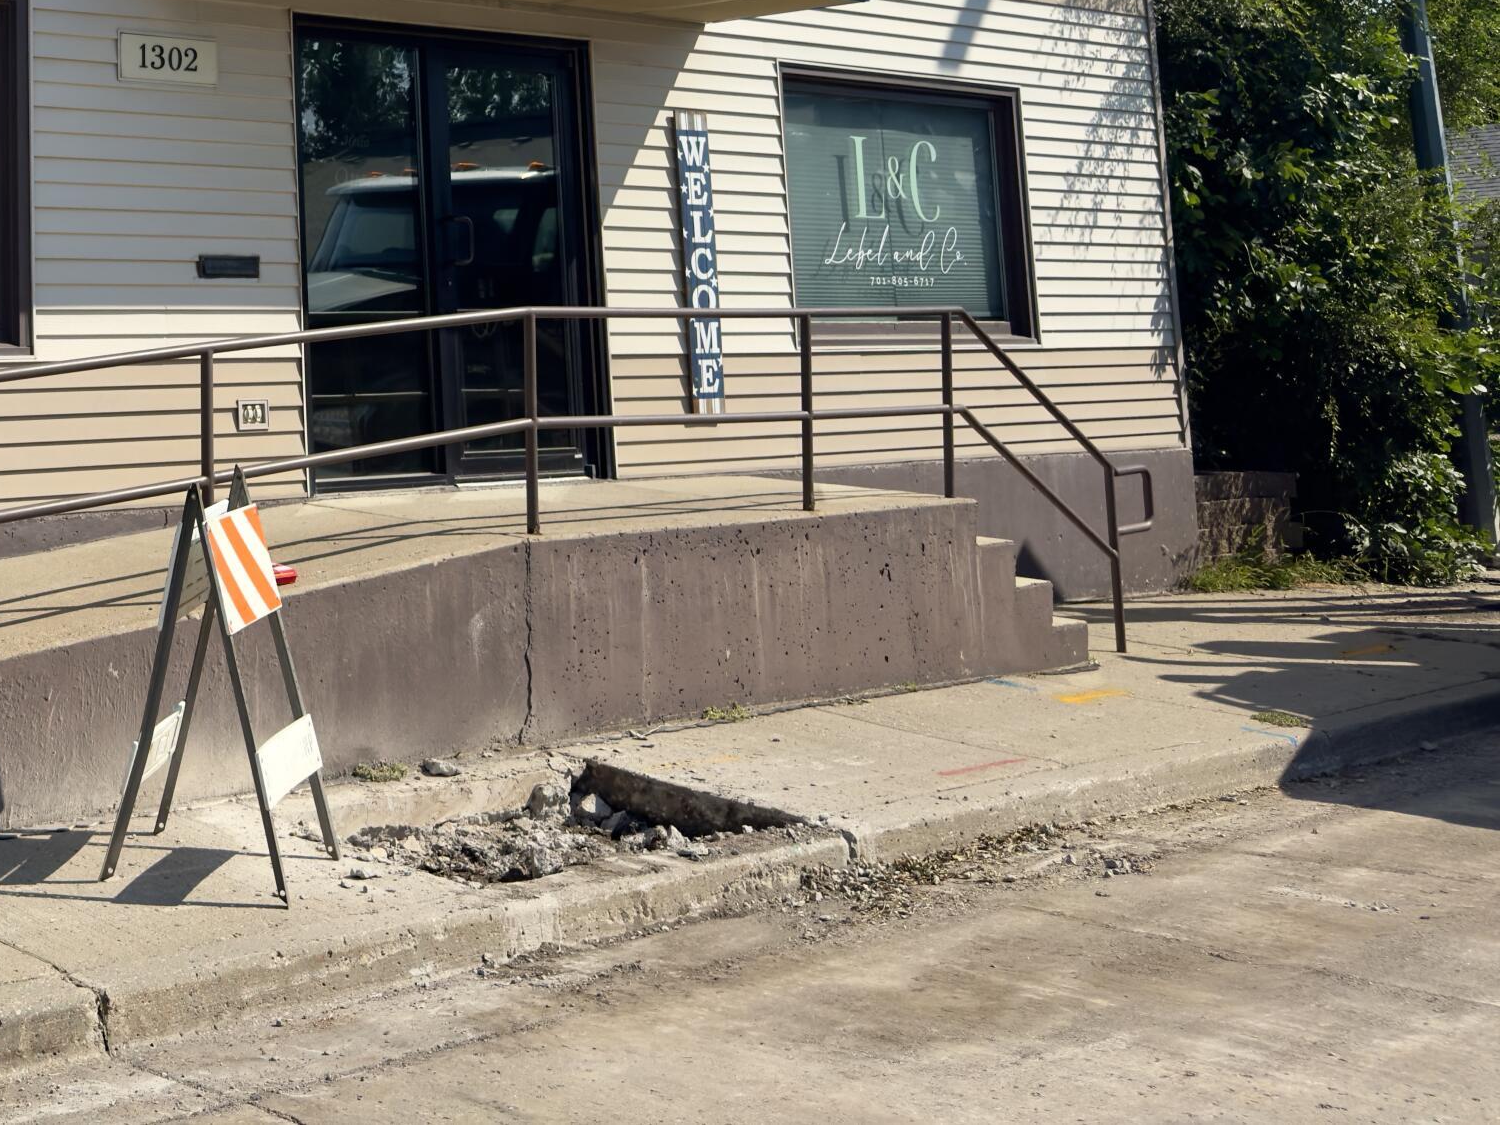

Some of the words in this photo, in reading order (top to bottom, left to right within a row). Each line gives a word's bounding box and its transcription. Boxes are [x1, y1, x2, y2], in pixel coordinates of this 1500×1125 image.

[138, 43, 198, 73] 1302
[678, 135, 721, 394] WELCOME
[892, 231, 936, 272] and
